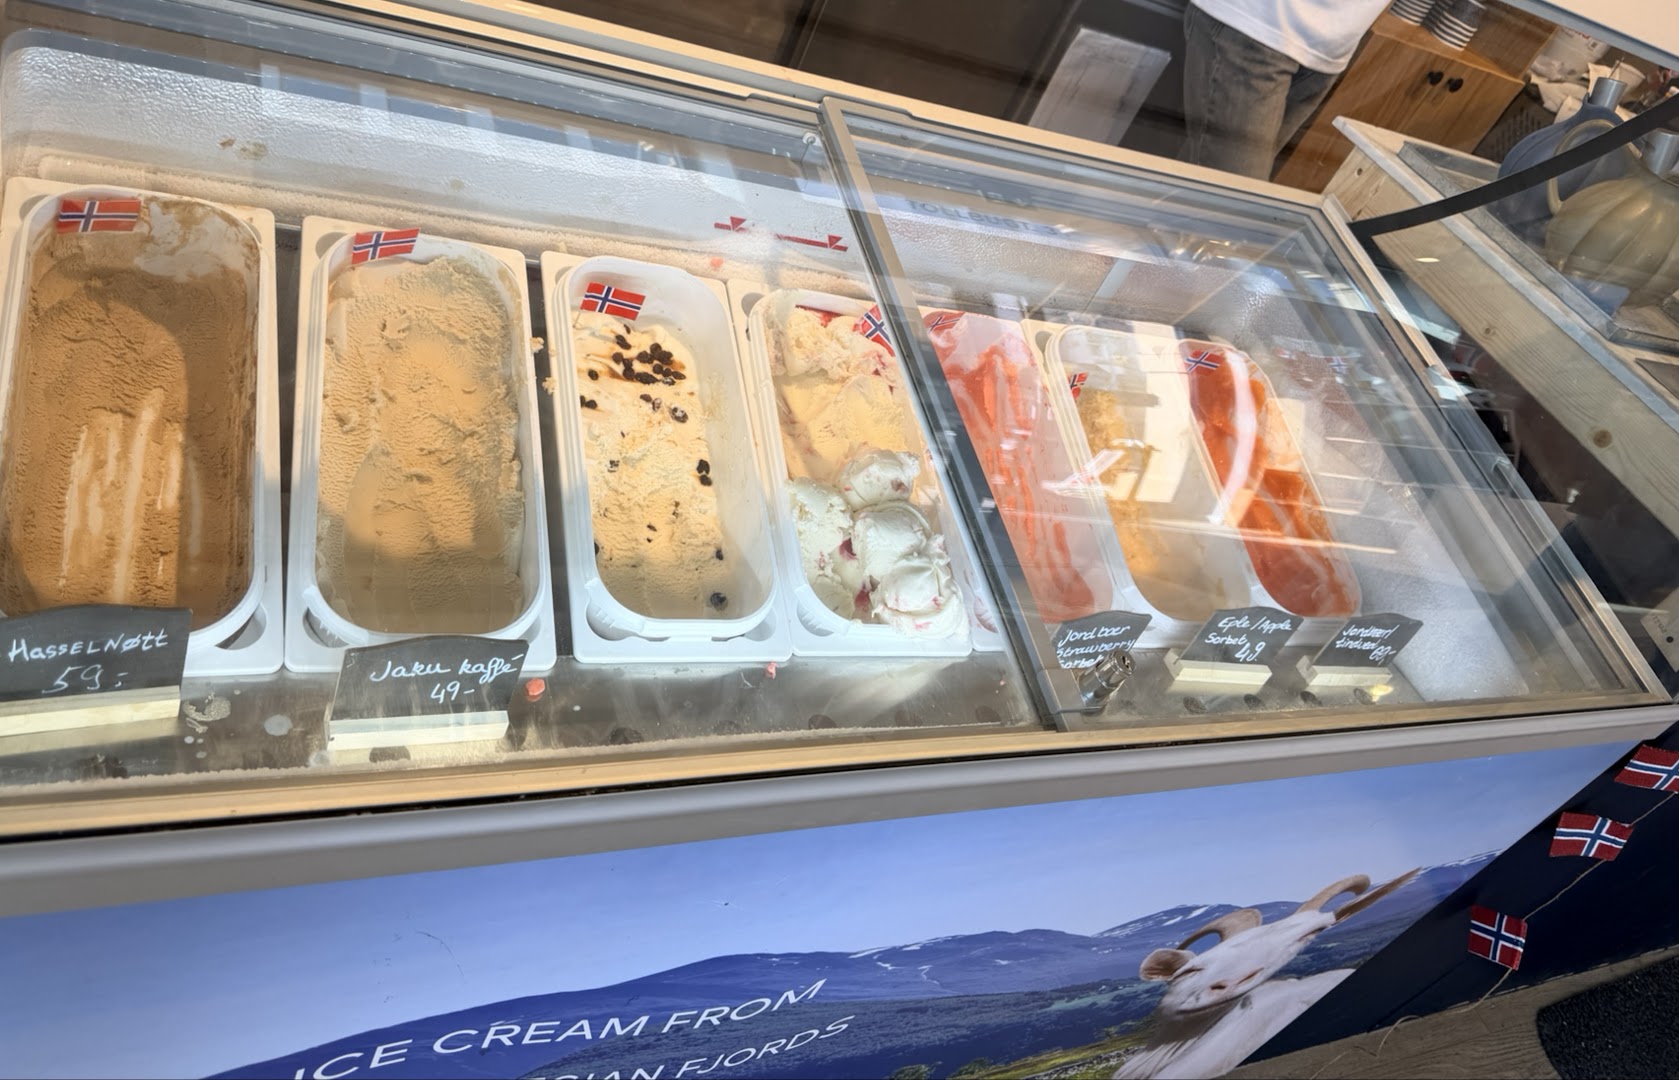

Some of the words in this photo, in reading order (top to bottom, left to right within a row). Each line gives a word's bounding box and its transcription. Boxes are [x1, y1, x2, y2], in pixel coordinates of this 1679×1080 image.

[1056, 638, 1136, 658] Strawberry
[1204, 632, 1248, 645] Sorbet
[432, 1016, 650, 1053] CREAM
[661, 978, 827, 1033] FROM
[675, 1015, 855, 1079] FJORDS
